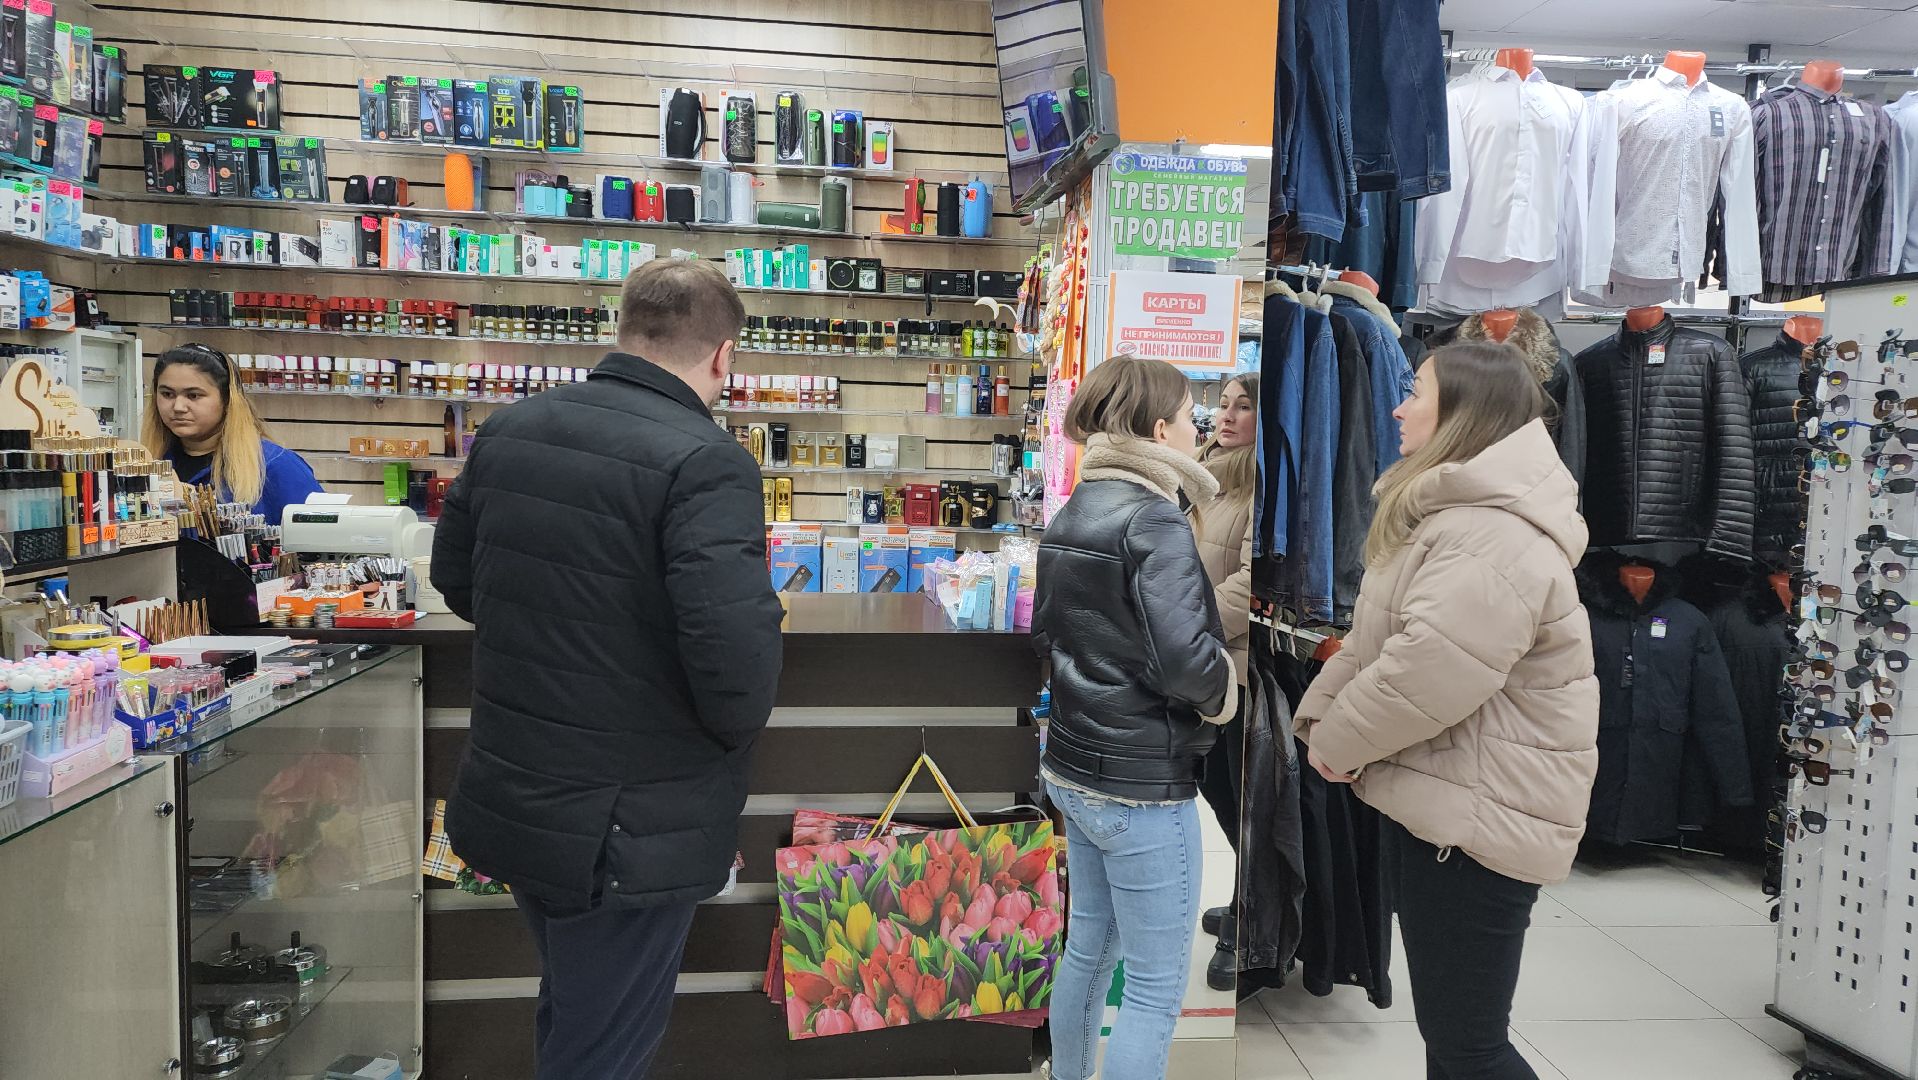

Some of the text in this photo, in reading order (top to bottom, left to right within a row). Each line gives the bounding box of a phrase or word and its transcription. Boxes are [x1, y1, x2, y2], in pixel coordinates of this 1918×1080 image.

[209, 70, 236, 79] VGR
[1140, 156, 1196, 172] ОДЕЖДА
[1207, 159, 1248, 173] ОБУВЬ
[1111, 180, 1246, 215] ТРЕБУЕТСЯ
[1110, 216, 1243, 252] ПРОДАВЕЦ
[1147, 296, 1201, 310] КАРТЫ
[1124, 330, 1137, 338] НЕ
[1139, 343, 1170, 356] СПАСИБО
[1171, 344, 1179, 357] ЗА
